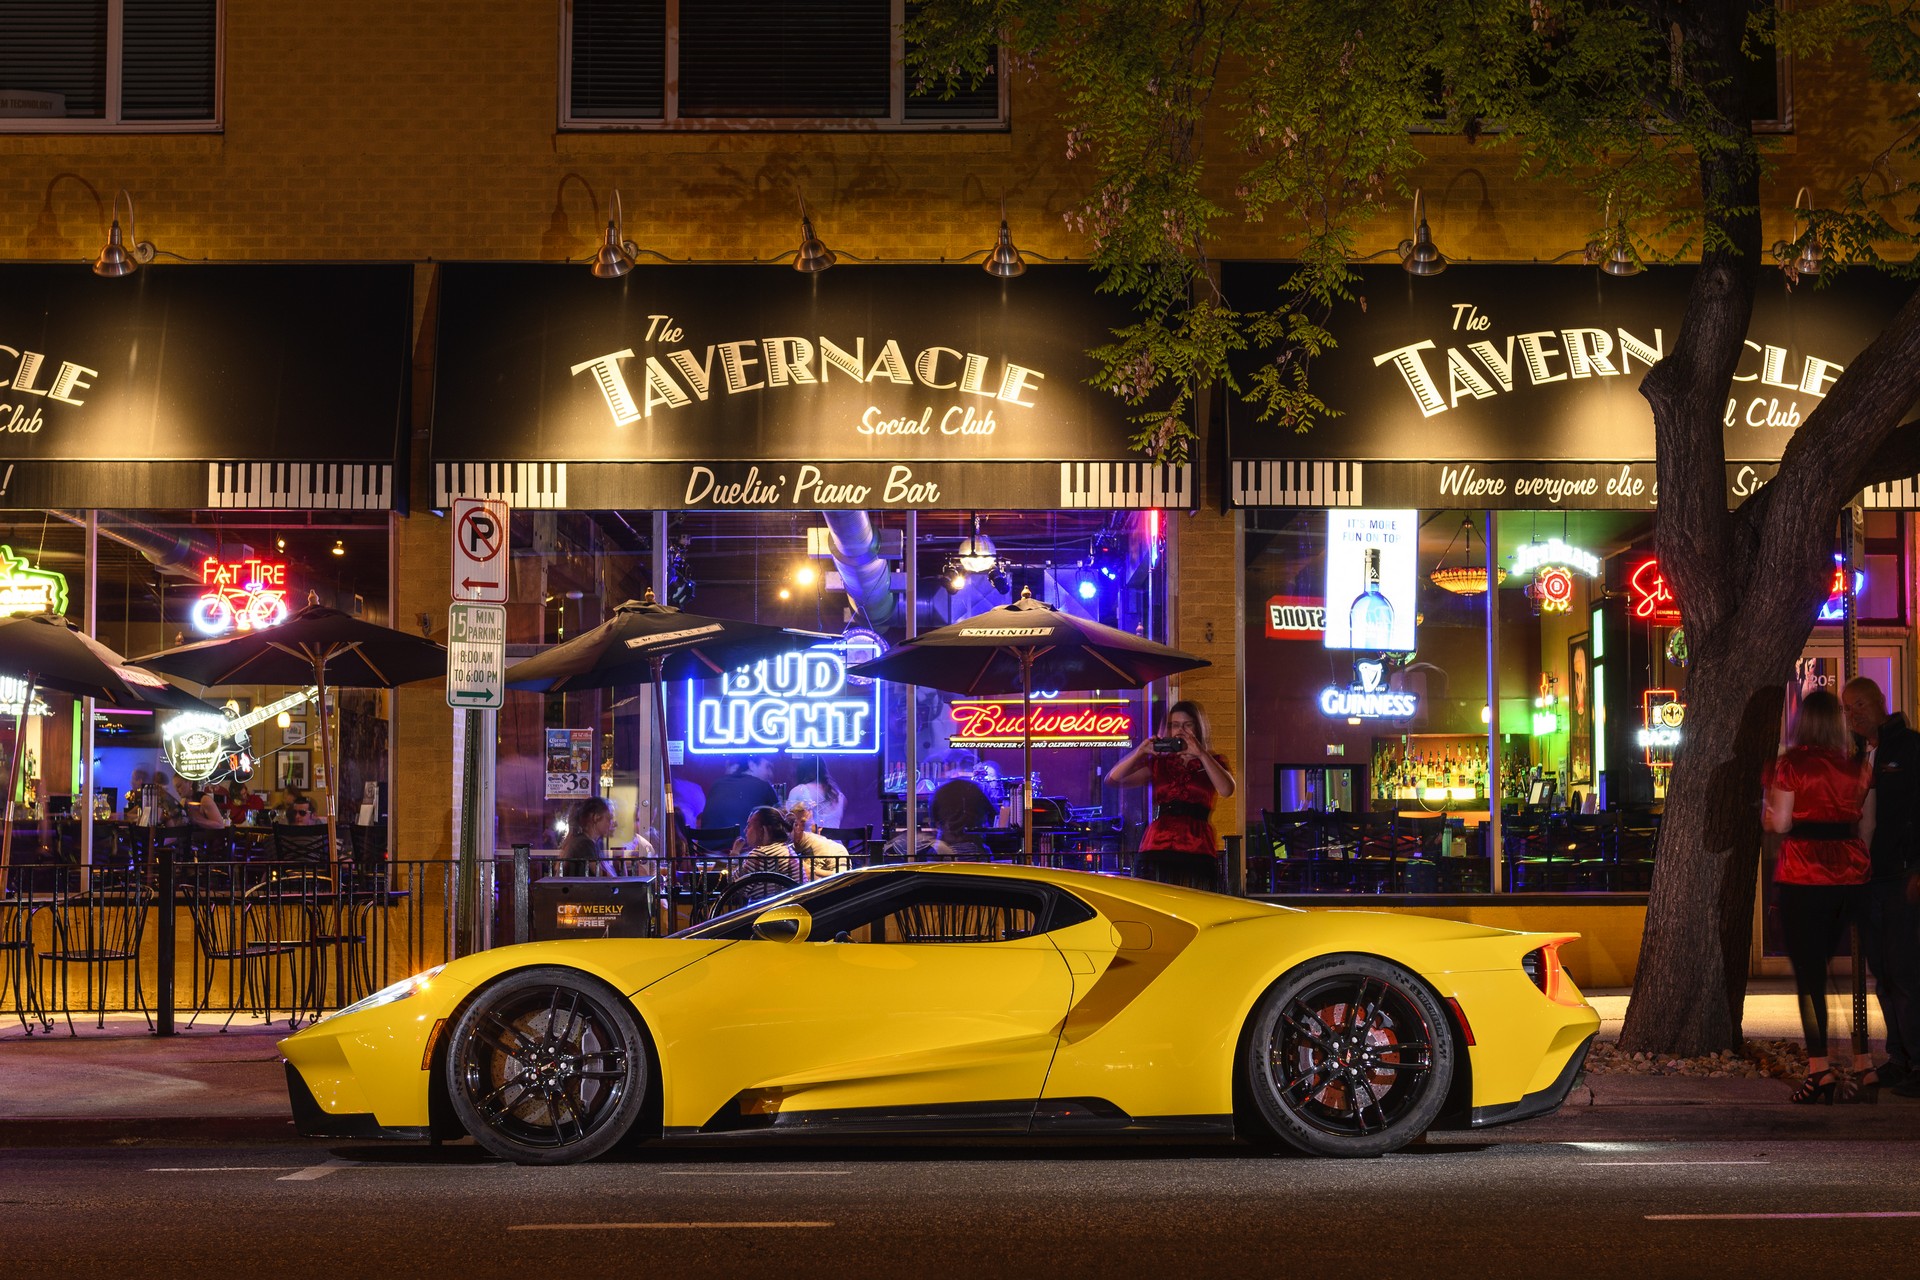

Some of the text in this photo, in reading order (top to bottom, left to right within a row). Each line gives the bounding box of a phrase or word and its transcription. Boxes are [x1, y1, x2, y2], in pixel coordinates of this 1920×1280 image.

[10, 99, 53, 110] TECHNOLOGY
[645, 315, 684, 342] The
[1451, 303, 1491, 331] The
[570, 336, 1044, 427] TAVERNACLE
[1373, 327, 1844, 418] TAVERNLE
[857, 405, 997, 435] Social Club
[1746, 397, 1801, 427] Club
[684, 465, 940, 504] Duelin' Piano Bar
[1440, 465, 1507, 497] Where
[1514, 476, 1599, 503] everyone
[1606, 466, 1646, 497] else
[1343, 532, 1402, 543] FUN ON TOP
[1347, 519, 1397, 530] IT'S MORE
[203, 557, 285, 584] FAT TIRE
[451, 610, 495, 637] 15 MIN
[468, 627, 502, 641] PARKING
[967, 628, 1048, 636] SMIRNOFF
[460, 650, 493, 664] 8:00 AM
[454, 669, 498, 684] TO 6:00 PM
[723, 652, 846, 696] BUD
[1812, 675, 1836, 687] 205
[1322, 689, 1416, 716] GUINNESS
[699, 697, 869, 748] LIGHT
[951, 705, 1130, 736] Budweiser
[1079, 740, 1106, 748] WINTER
[1106, 740, 1131, 748] GAMES
[558, 904, 624, 914] CITY WEEKLY
